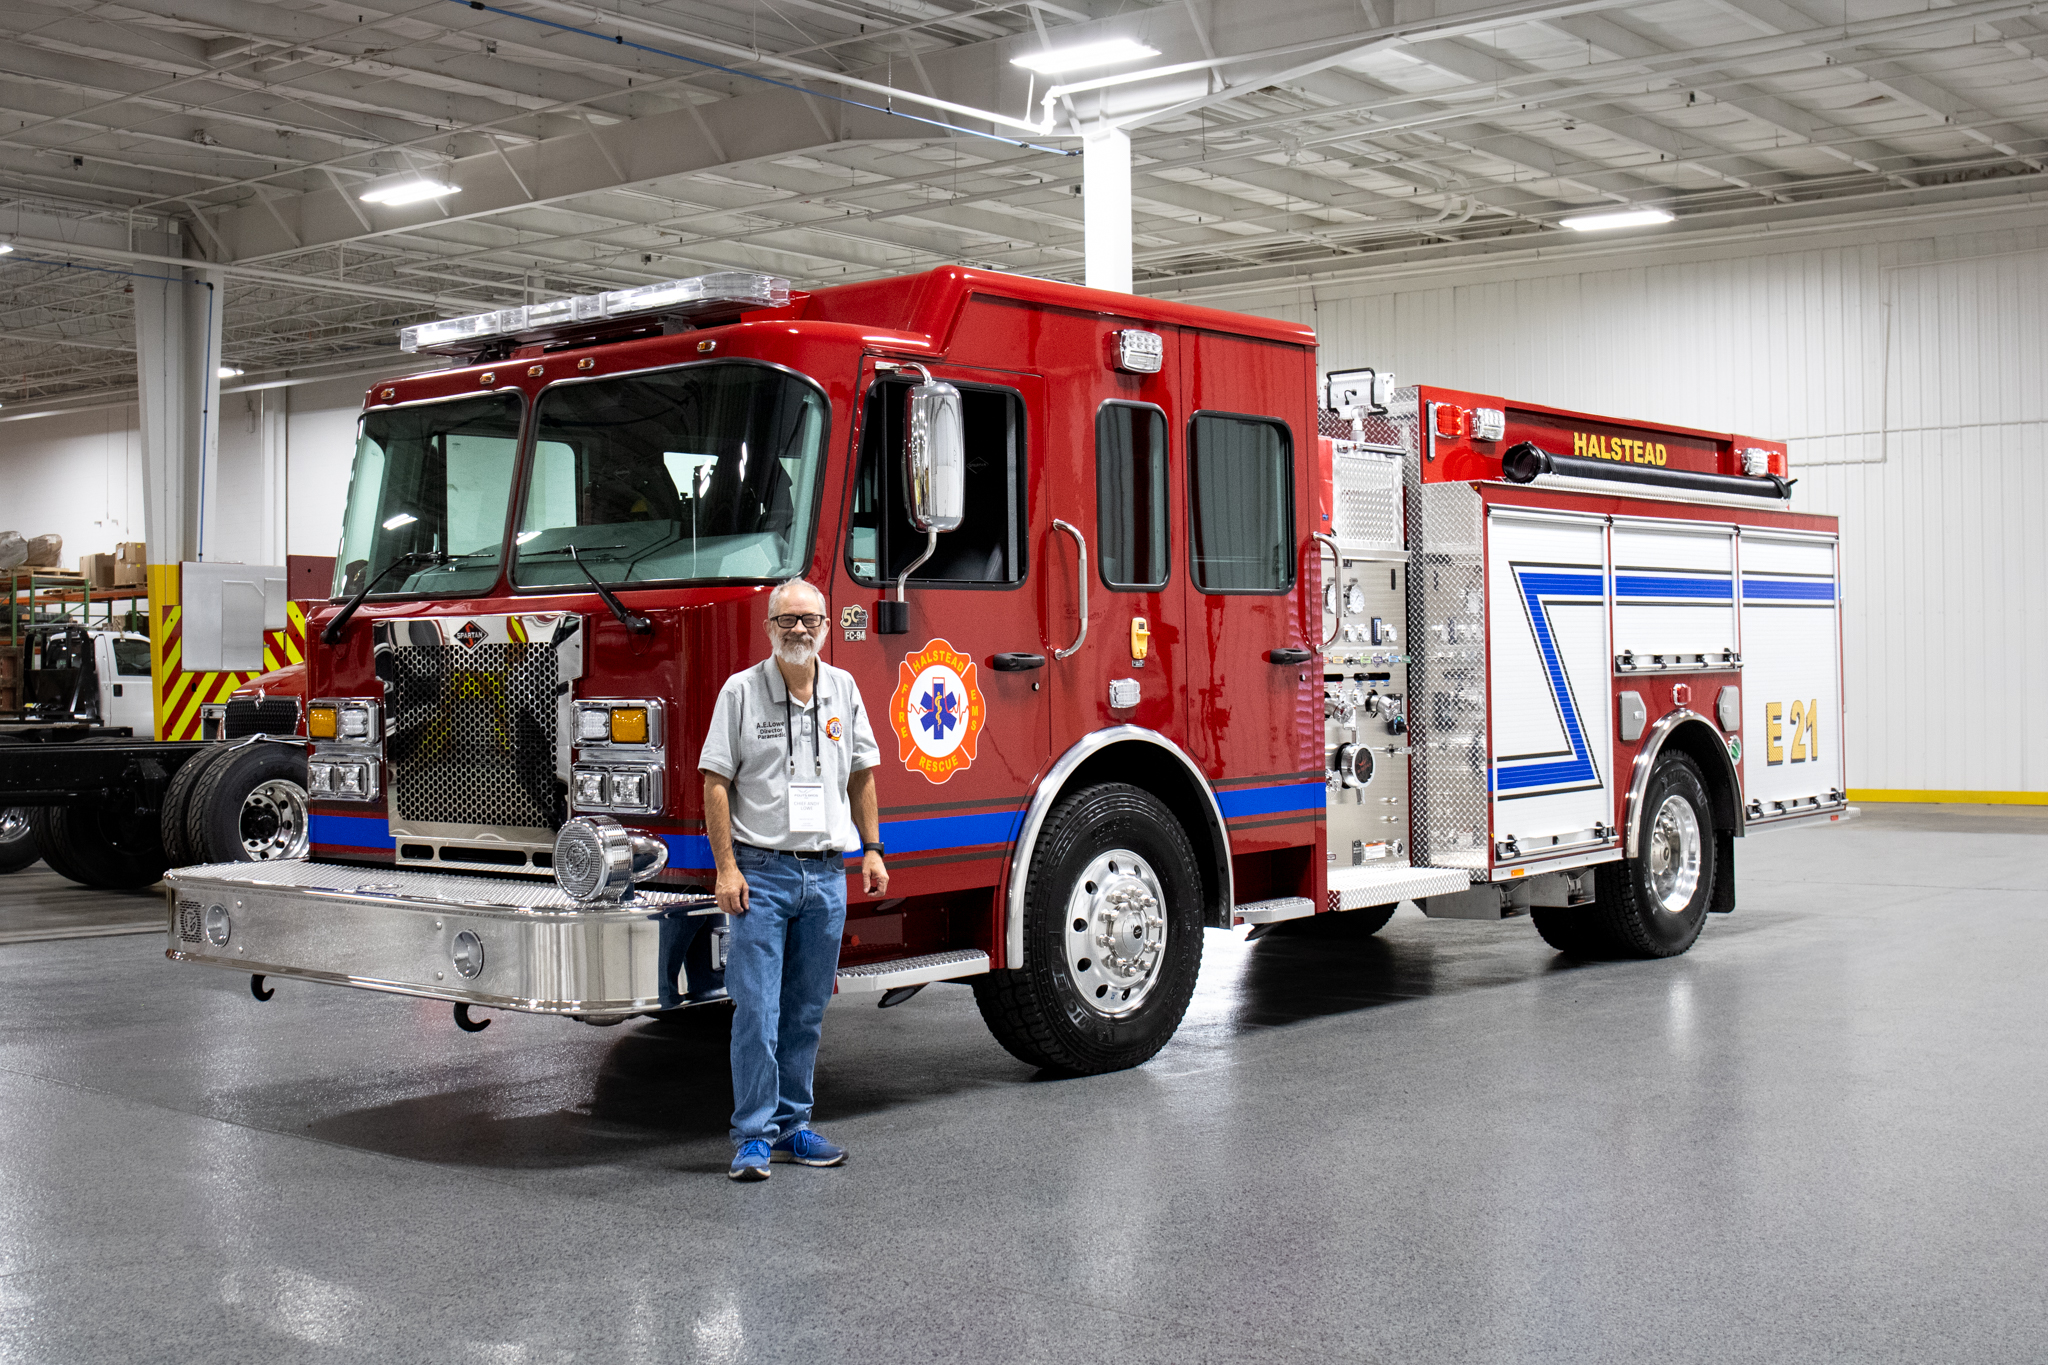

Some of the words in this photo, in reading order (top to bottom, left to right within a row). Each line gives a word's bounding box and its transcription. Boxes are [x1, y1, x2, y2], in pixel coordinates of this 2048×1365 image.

[1573, 431, 1667, 466] HALSTEAD
[456, 631, 483, 640] SPARTAN
[845, 631, 866, 640] FC-94
[912, 650, 965, 673] HALSTEAD
[898, 683, 909, 739] FIRE
[970, 689, 979, 731] EMS
[757, 732, 786, 740] Paramedic
[1765, 701, 1783, 766] E
[1790, 698, 1818, 764] 21
[918, 754, 959, 773] RESCUE
